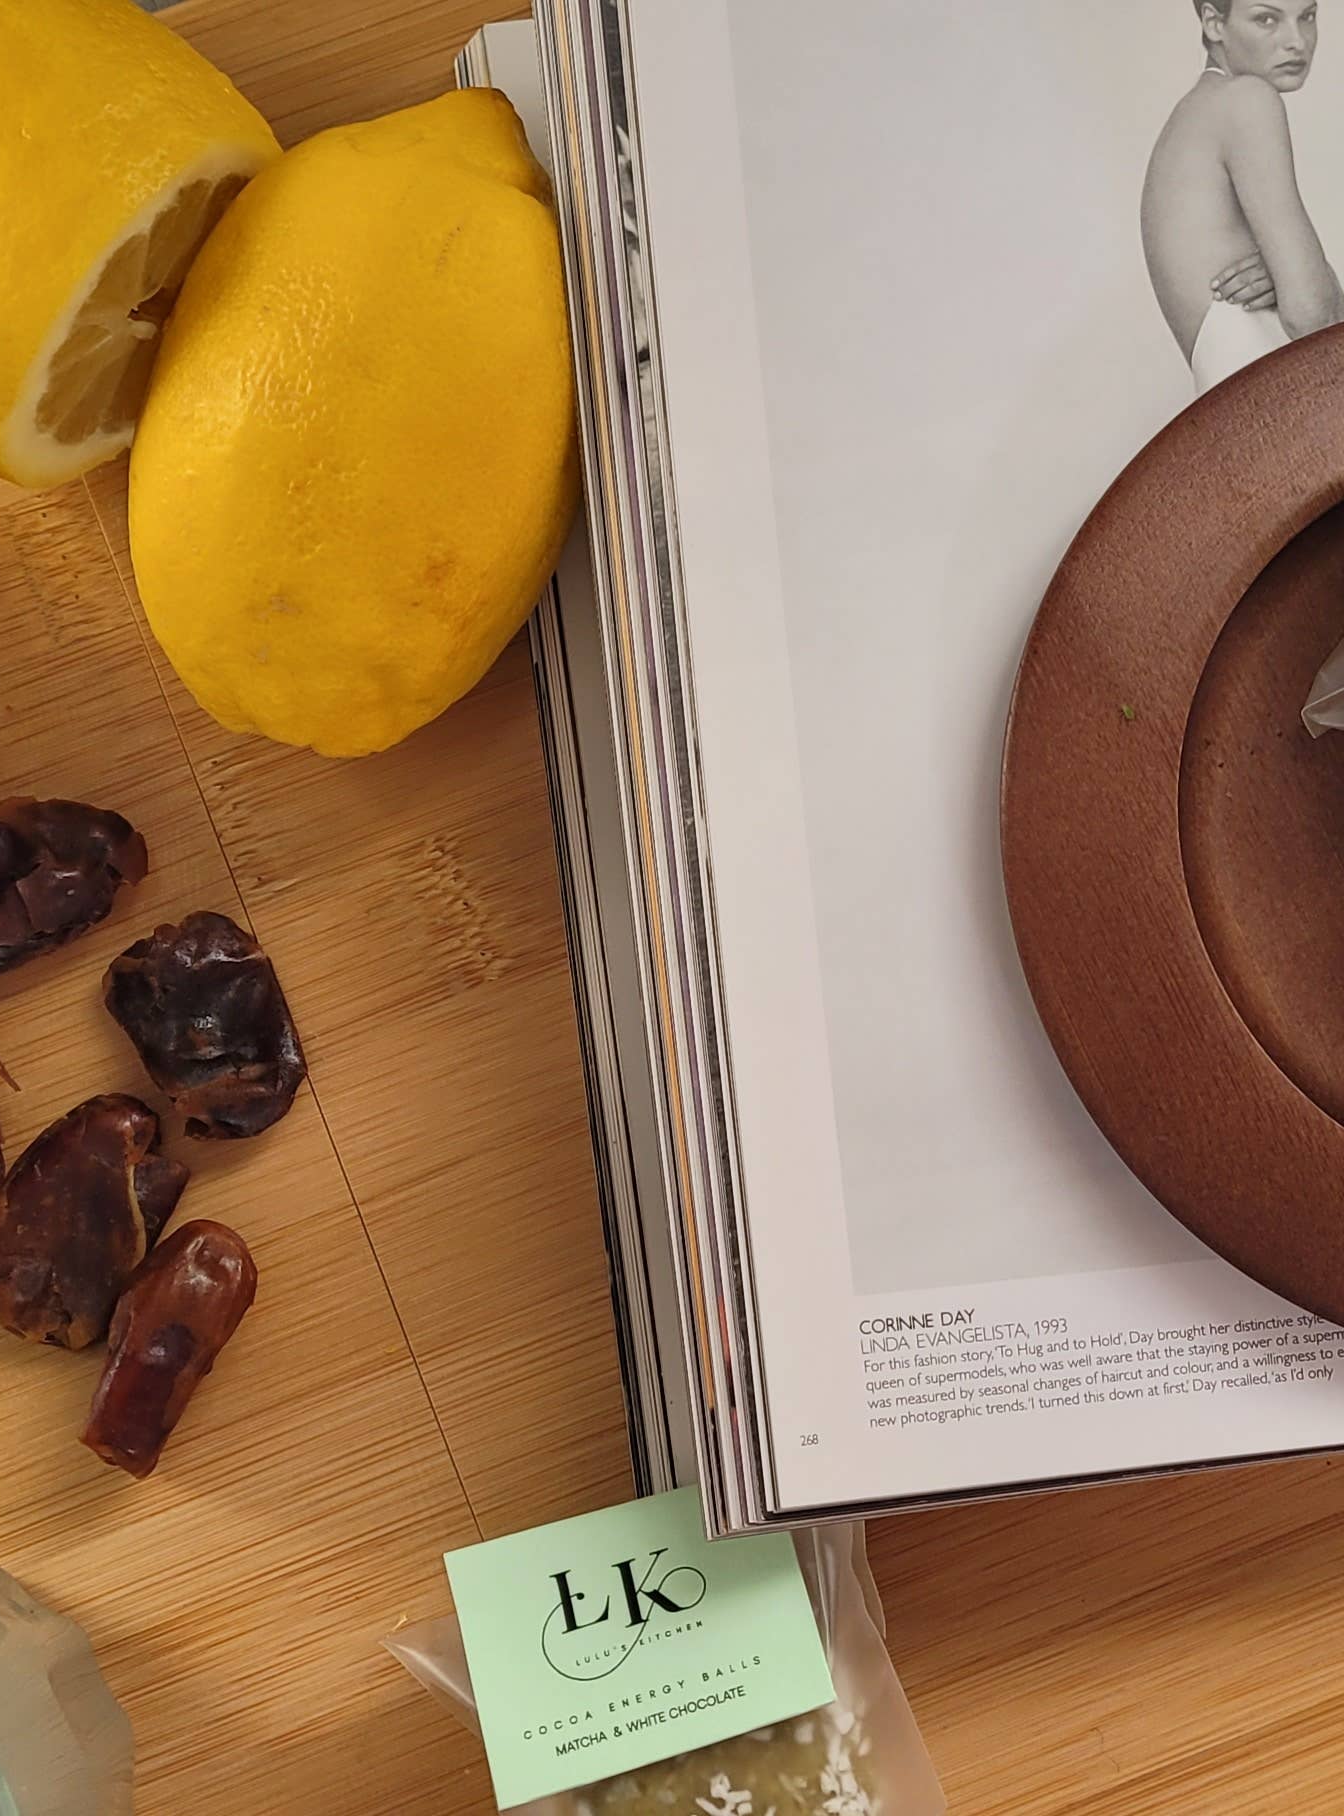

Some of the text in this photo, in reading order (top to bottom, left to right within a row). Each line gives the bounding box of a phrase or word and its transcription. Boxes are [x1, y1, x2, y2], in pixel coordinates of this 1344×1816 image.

[859, 1309, 975, 1335] CORINNE DAY
[860, 1318, 1068, 1355] LINDA EVANGELISTA, 1993
[864, 1360, 886, 1373] For
[889, 1356, 910, 1370] this
[914, 1353, 956, 1368] fashion
[961, 1349, 994, 1363] story,
[1017, 1342, 1044, 1358] Hug
[1046, 1339, 1069, 1352] and
[1073, 1337, 1086, 1349] to
[1129, 1330, 1154, 1345] Day
[1157, 1322, 1207, 1342] brought
[1209, 1323, 1230, 1336] her
[1234, 1315, 1294, 1333] distinctive
[866, 1377, 904, 1393] queen
[909, 1373, 922, 1386] of
[925, 1366, 1006, 1388] supermodels,
[1009, 1361, 1037, 1375] who
[1040, 1360, 1064, 1372] was
[1067, 1354, 1092, 1369] well
[1096, 1353, 1133, 1367] aware
[1137, 1348, 1160, 1362] that
[1164, 1345, 1184, 1358] the
[1188, 1341, 1230, 1359] staying
[1232, 1338, 1273, 1354] power
[1276, 1333, 1289, 1347] of
[1292, 1334, 1300, 1345] a
[867, 1397, 892, 1409] was
[895, 1389, 956, 1407] measured
[960, 1387, 974, 1401] by
[978, 1381, 1029, 1398] seasonal
[1033, 1375, 1082, 1391] changes
[1085, 1372, 1098, 1385] of
[1101, 1367, 1143, 1382] haircut
[1147, 1364, 1169, 1378] and
[1173, 1360, 1214, 1375] colour,
[1216, 1357, 1239, 1371] and
[1242, 1358, 1250, 1369] a
[1252, 1350, 1316, 1367] willingness
[1320, 1348, 1333, 1360] to
[870, 1414, 896, 1428] new
[900, 1406, 984, 1428] photographic
[986, 1399, 1027, 1415] trends.
[1038, 1394, 1080, 1410] turned
[1084, 1390, 1105, 1403] this
[1108, 1386, 1144, 1401] down
[1147, 1385, 1160, 1397] at
[1192, 1378, 1217, 1393] Day
[1308, 1366, 1334, 1382] only
[799, 1433, 819, 1447] 268
[523, 1655, 761, 1740] COCOA ENERGY BALLS
[555, 1685, 747, 1757] MATCHA & WHITE CHOCOLATE
